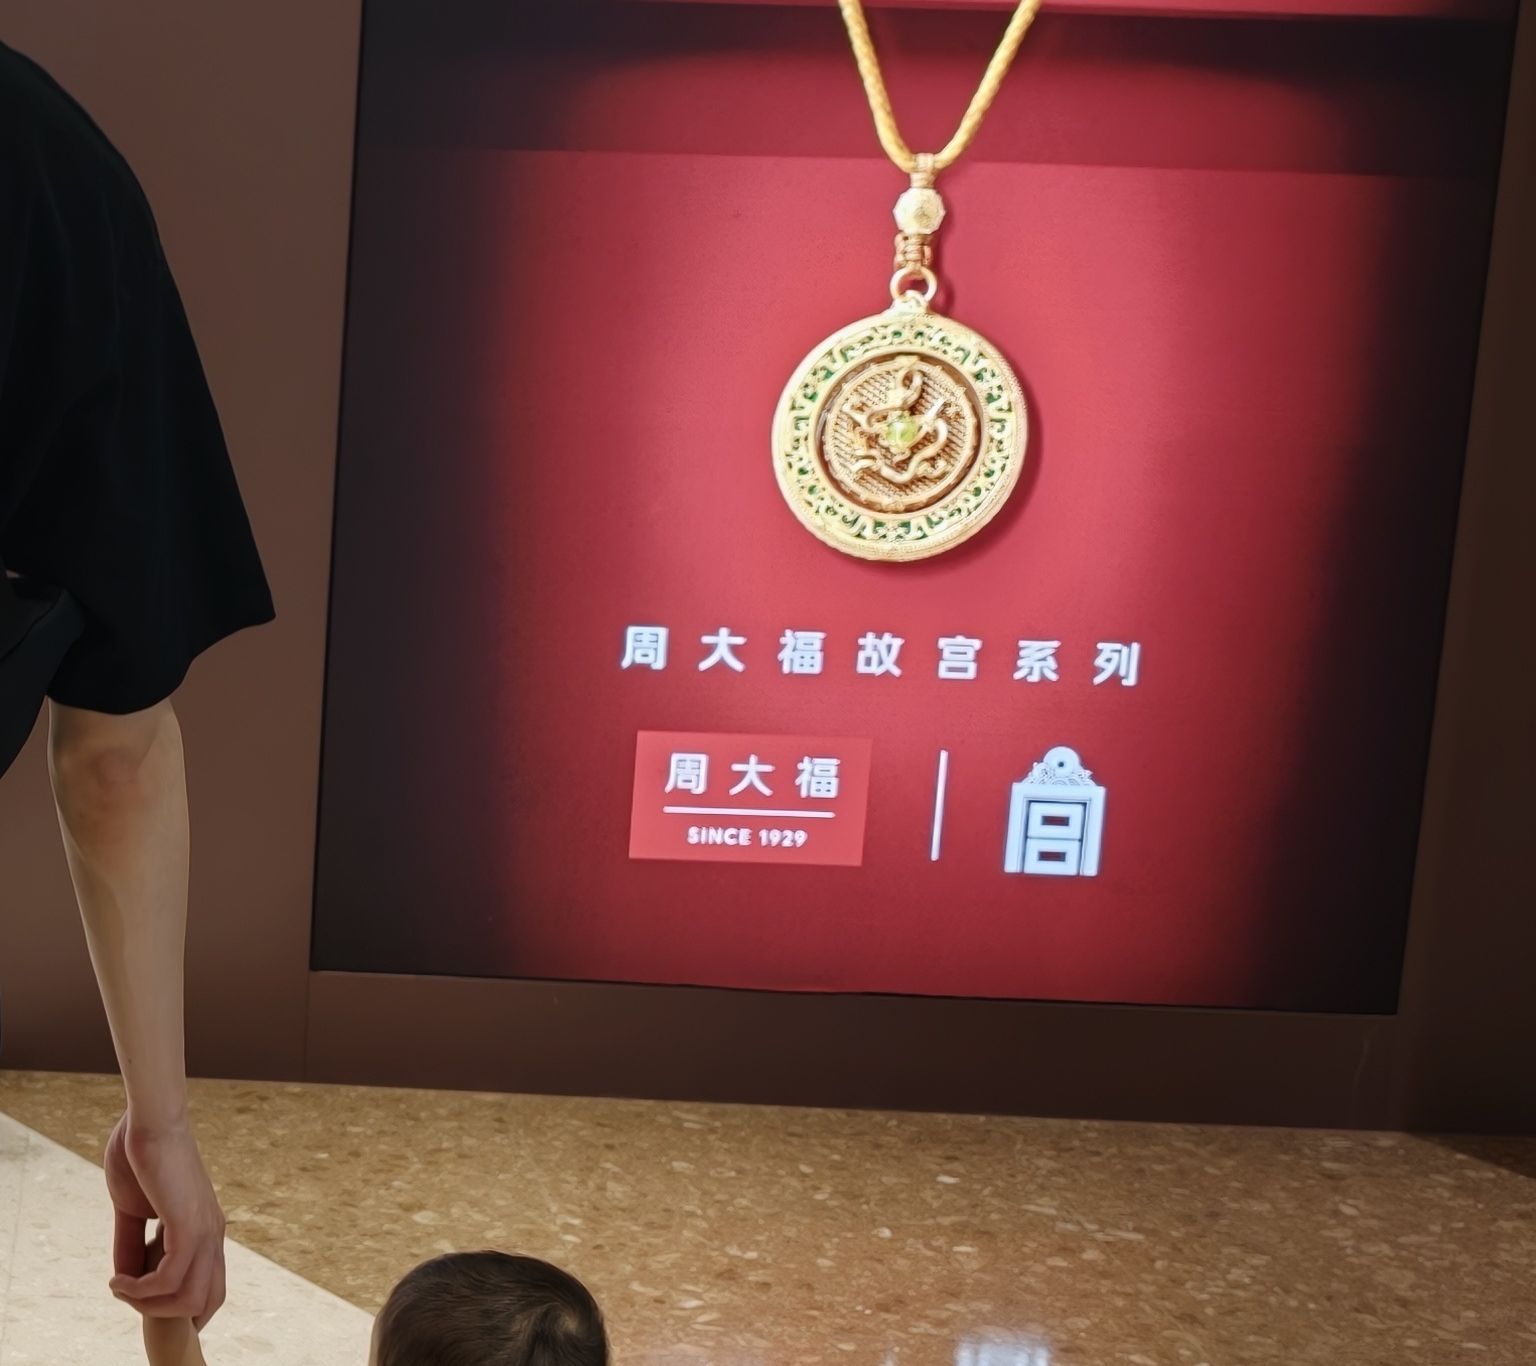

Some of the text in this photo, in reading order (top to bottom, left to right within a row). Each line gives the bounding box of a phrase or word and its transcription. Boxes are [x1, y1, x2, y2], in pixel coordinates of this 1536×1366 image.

[621, 625, 1141, 686] 周大福故宫系列
[664, 752, 840, 798] 周大福
[687, 826, 808, 847] SINCE 1929
